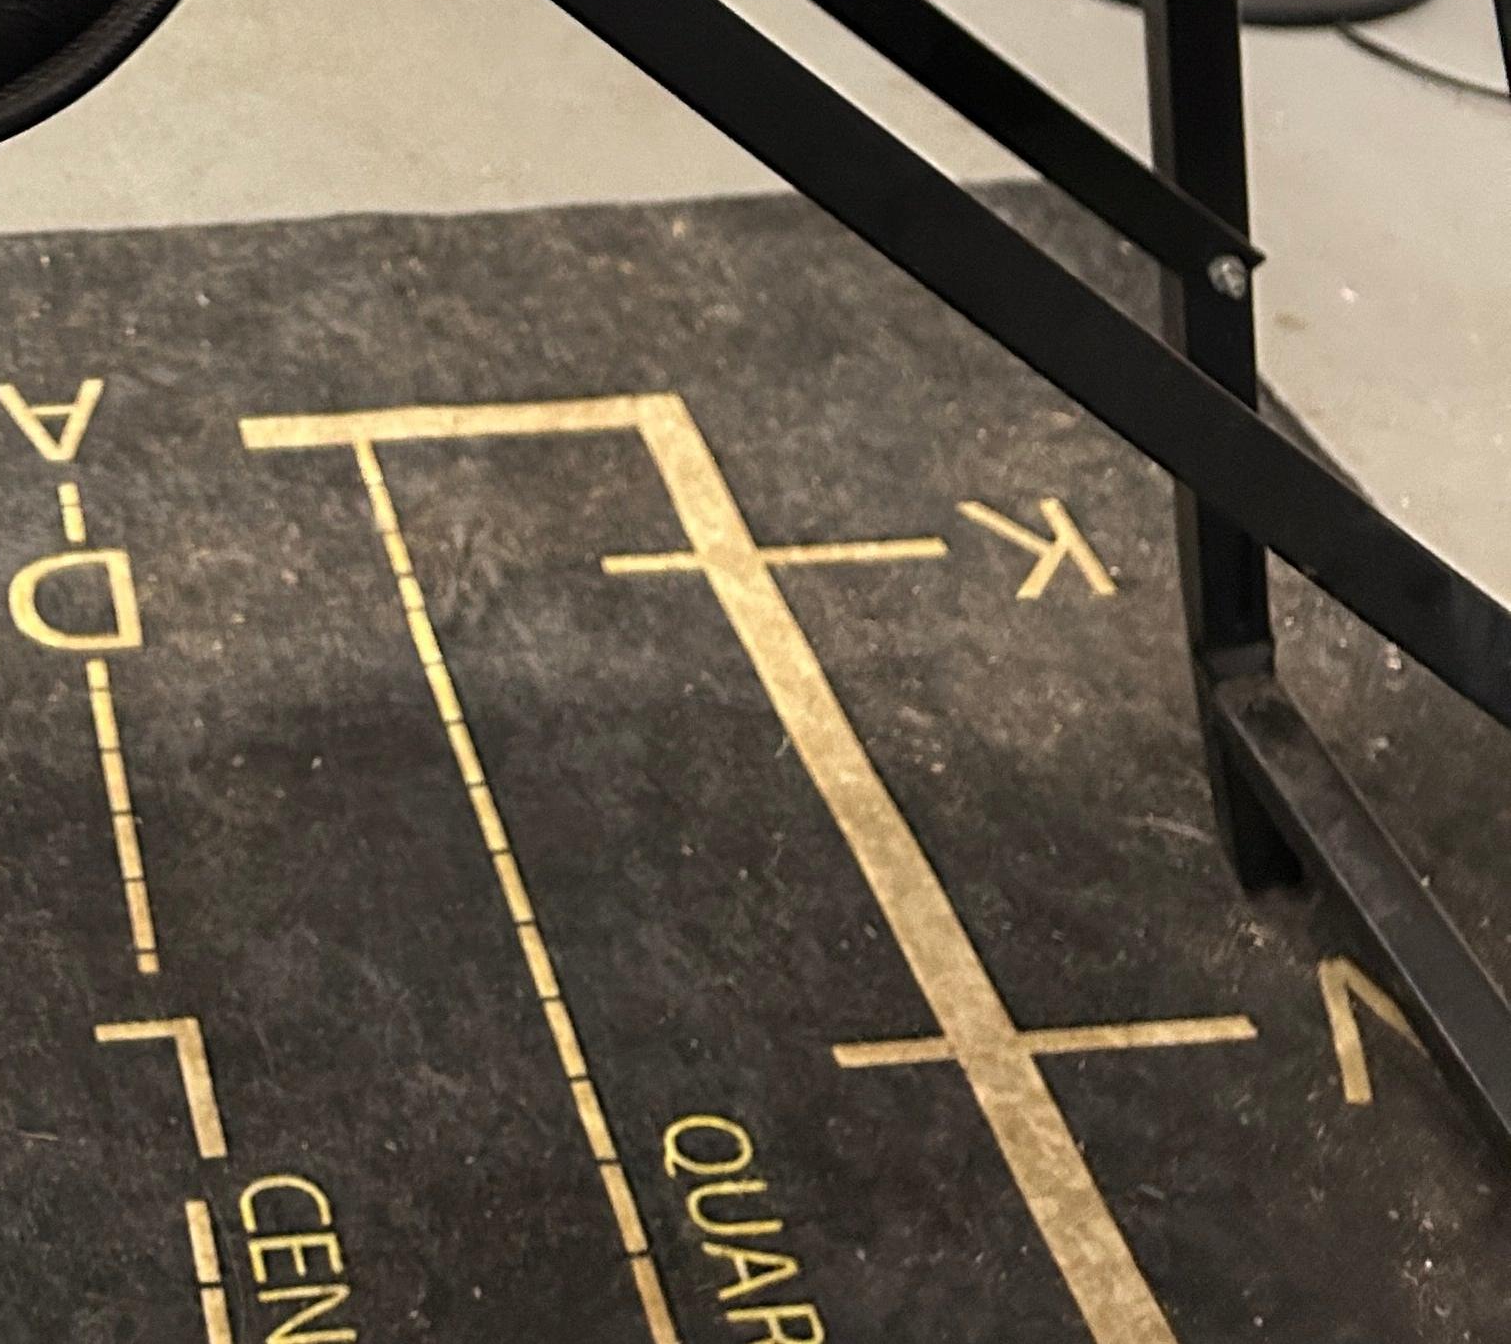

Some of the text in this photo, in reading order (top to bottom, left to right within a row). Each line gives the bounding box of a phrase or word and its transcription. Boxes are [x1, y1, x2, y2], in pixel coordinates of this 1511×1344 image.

[8, 549, 142, 649] D
[956, 497, 1117, 600] K
[240, 1174, 357, 1344] CEN
